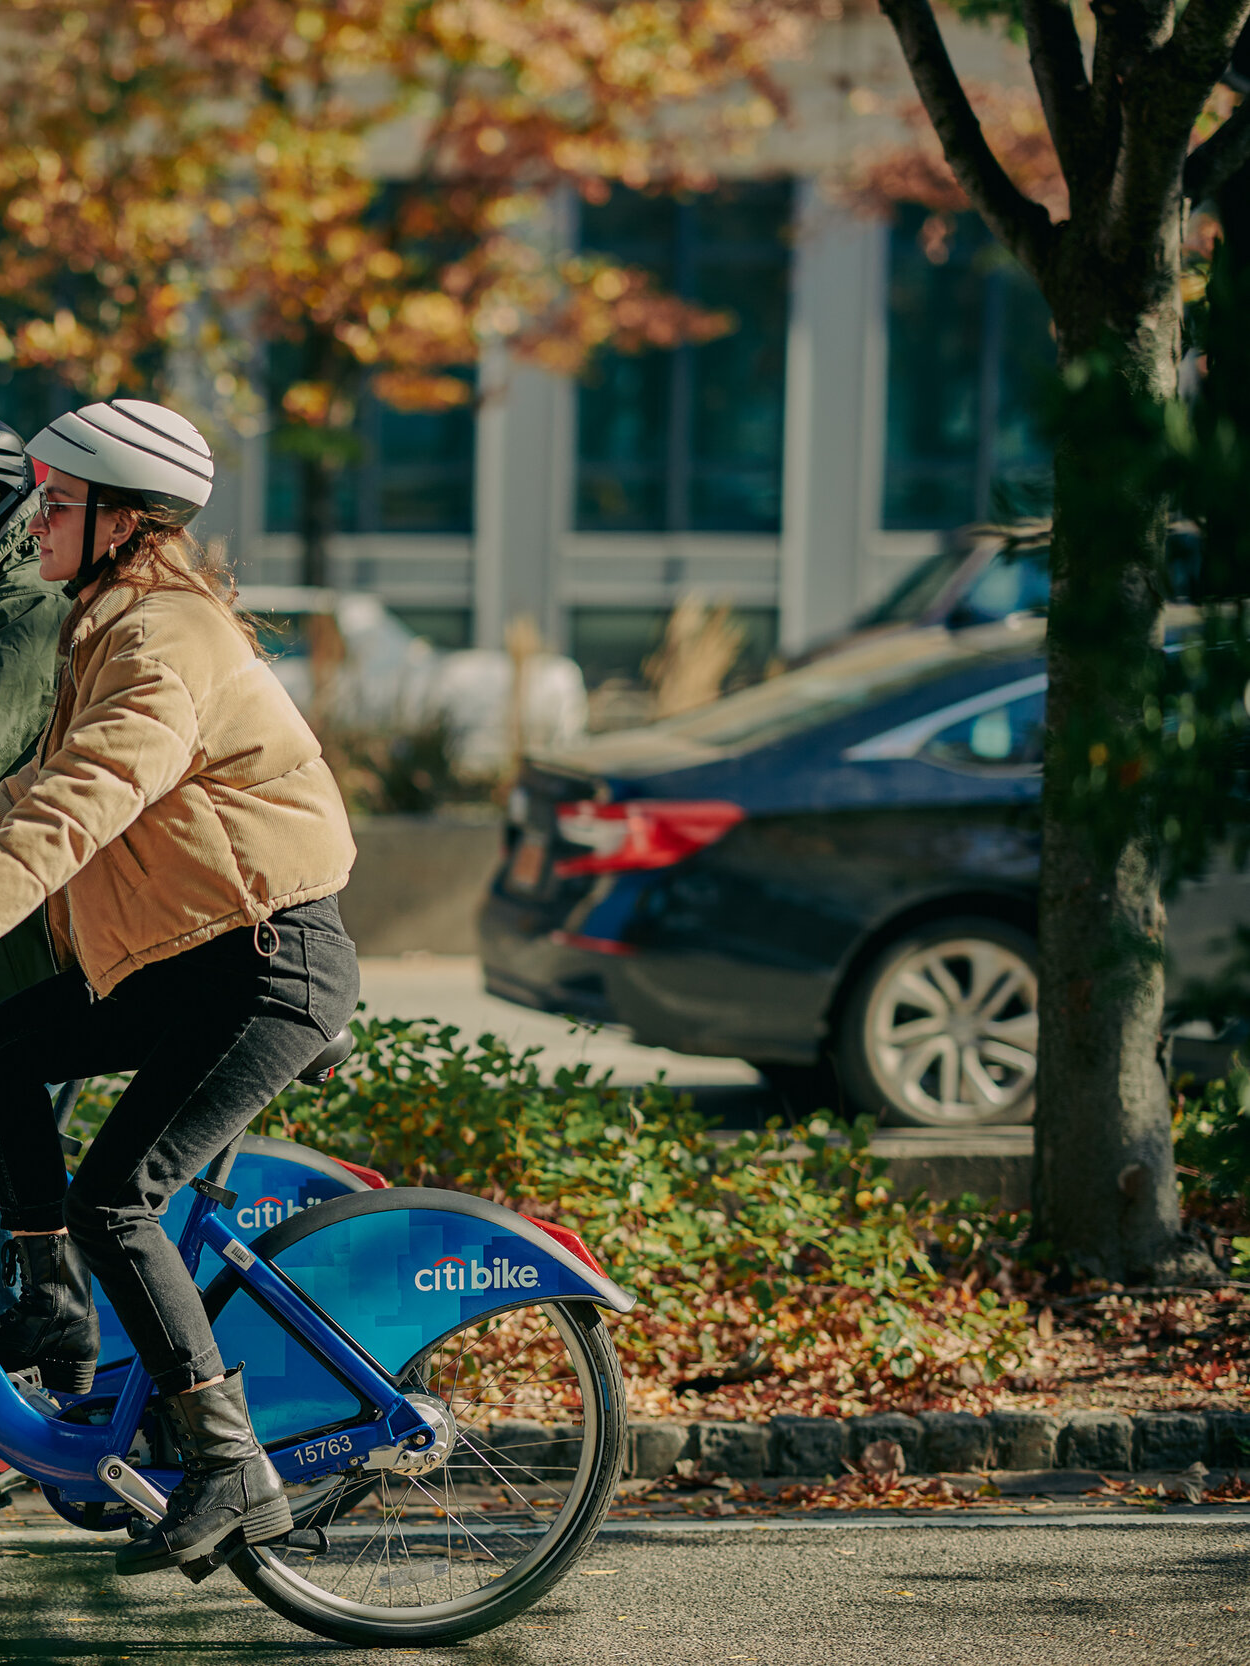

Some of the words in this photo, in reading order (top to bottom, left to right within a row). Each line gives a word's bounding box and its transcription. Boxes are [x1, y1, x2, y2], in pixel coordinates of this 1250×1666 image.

[236, 1196, 284, 1229] citi
[414, 1256, 466, 1291] citi
[294, 1435, 353, 1465] 15763
